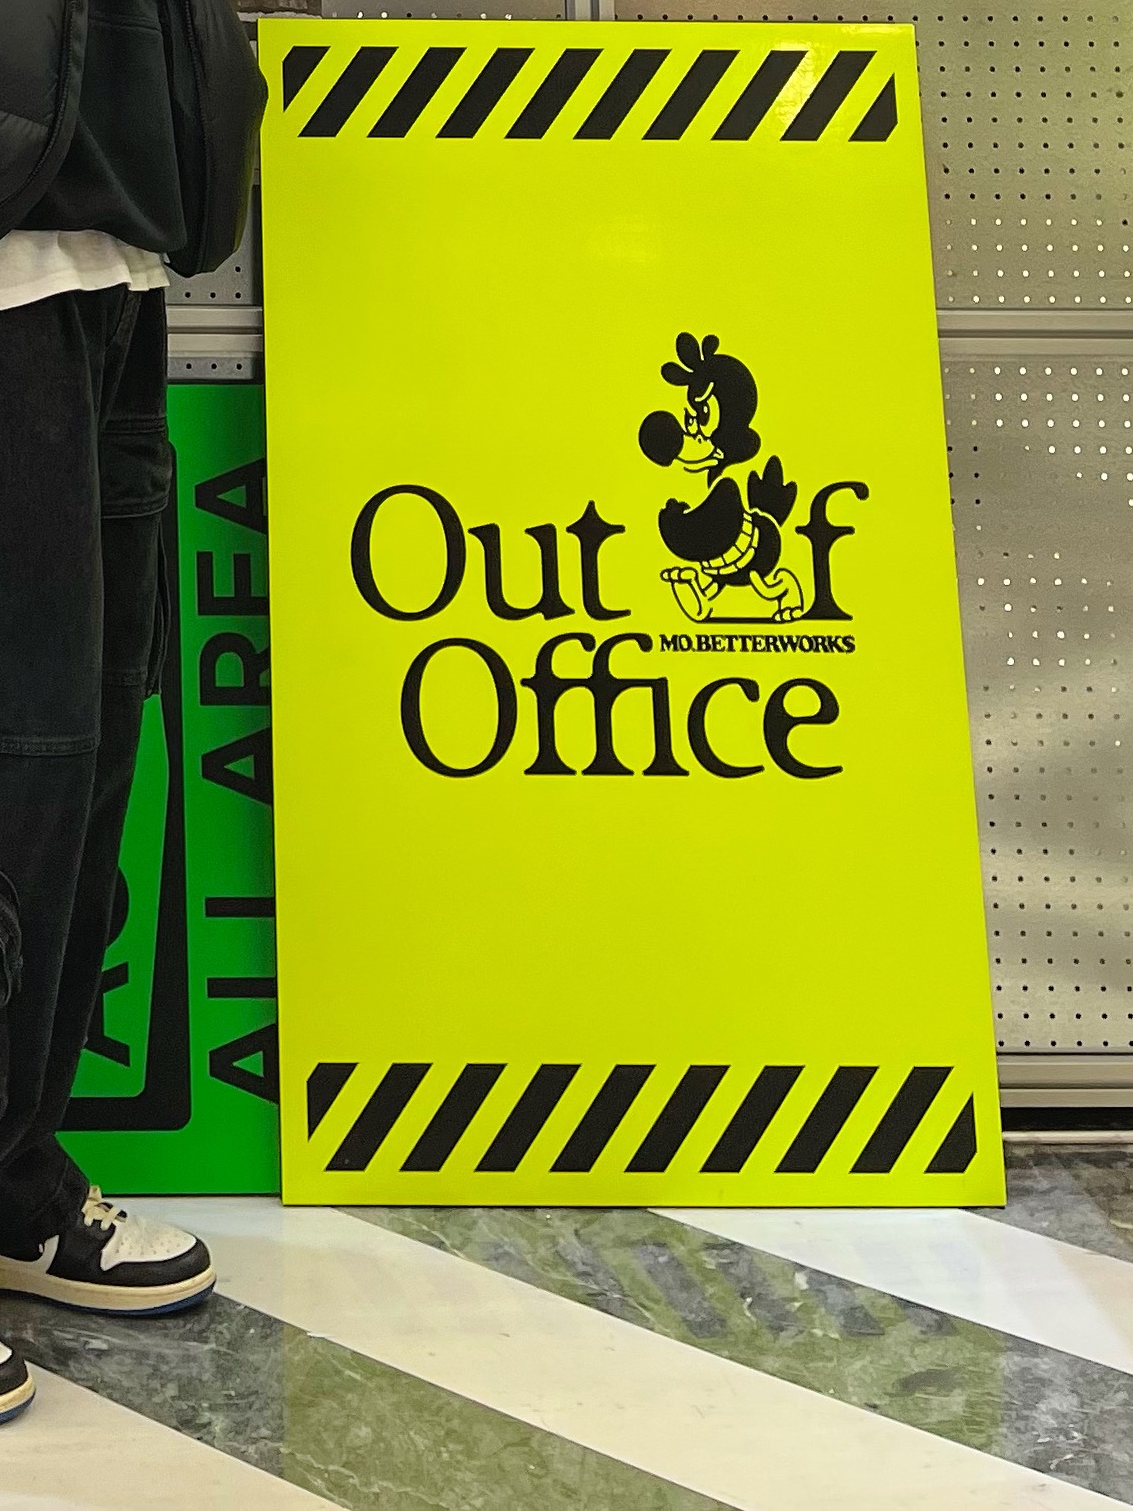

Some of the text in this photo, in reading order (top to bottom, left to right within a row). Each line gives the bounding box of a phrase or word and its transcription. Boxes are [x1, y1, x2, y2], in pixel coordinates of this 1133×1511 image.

[350, 484, 631, 622] Out
[399, 632, 844, 779] Office
[658, 634, 856, 653] MO.BETTERWORKS
